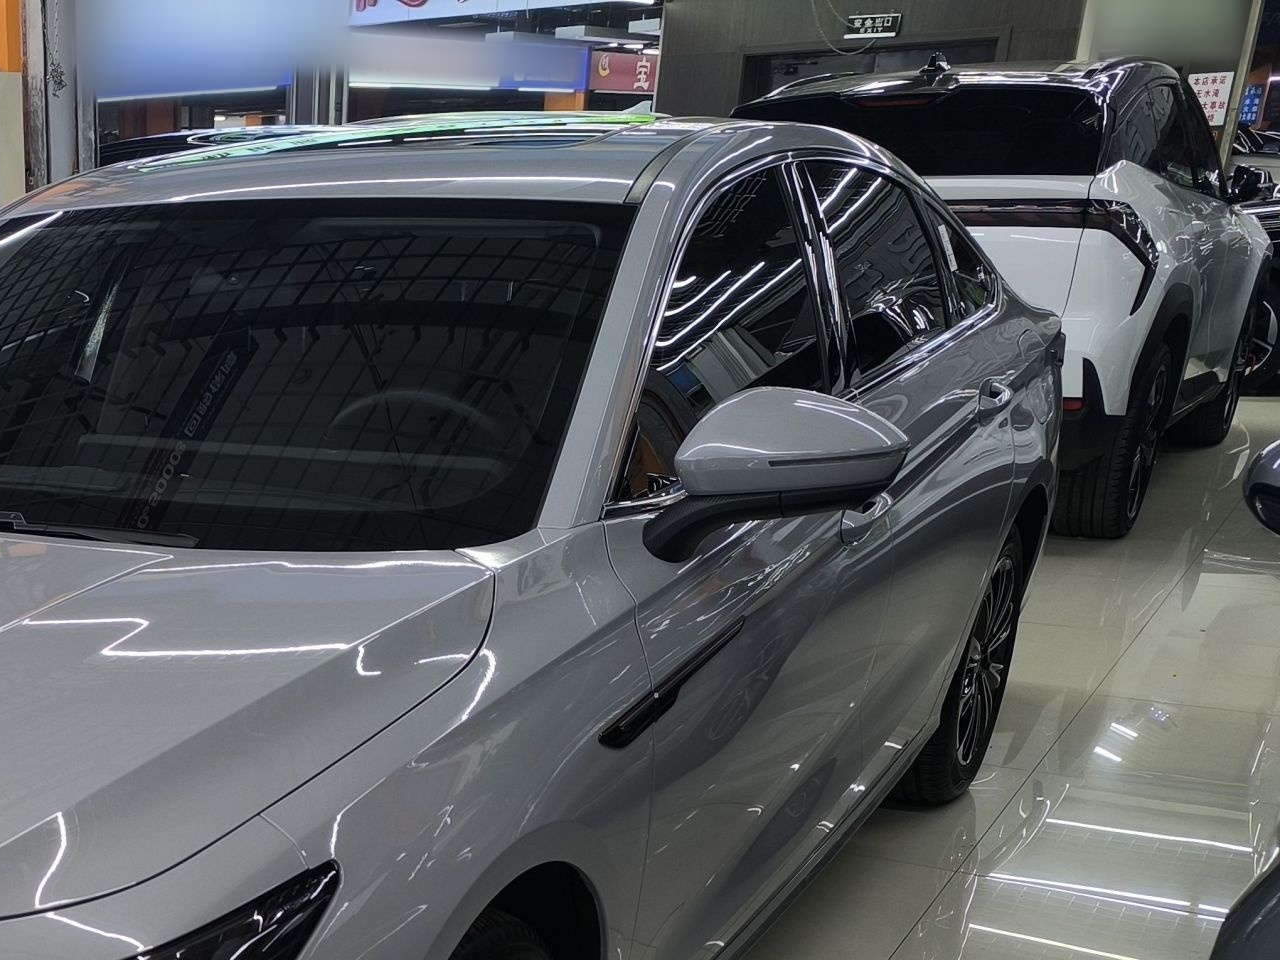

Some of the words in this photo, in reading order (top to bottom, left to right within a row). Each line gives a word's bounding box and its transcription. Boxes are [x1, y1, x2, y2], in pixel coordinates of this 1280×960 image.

[854, 17, 892, 28] 安全出口
[1193, 75, 1227, 86] 本店承诺
